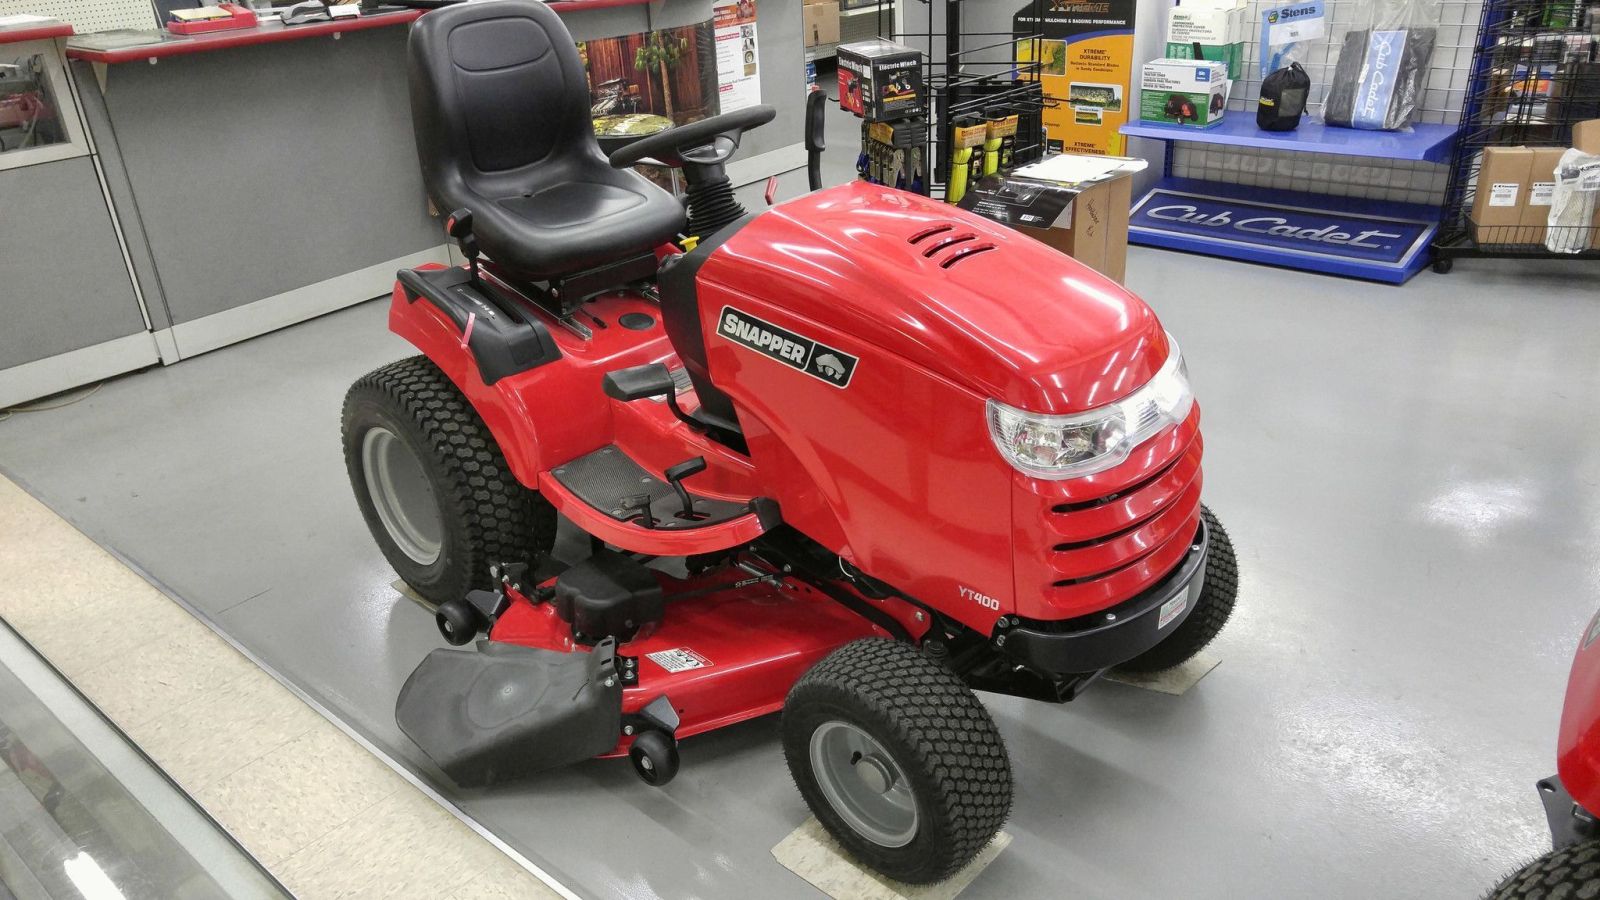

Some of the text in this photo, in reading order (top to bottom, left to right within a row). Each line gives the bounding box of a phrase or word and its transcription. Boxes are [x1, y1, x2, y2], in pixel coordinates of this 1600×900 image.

[1281, 6, 1316, 19] Stens
[879, 60, 917, 71] Electric Winch
[1362, 41, 1392, 119] Cub Cadet
[1065, 147, 1106, 155] EFFECTIVENESS
[1146, 205, 1401, 249] Cub Cadet
[723, 313, 806, 364] SNAPPER
[958, 584, 1000, 611] YT400
